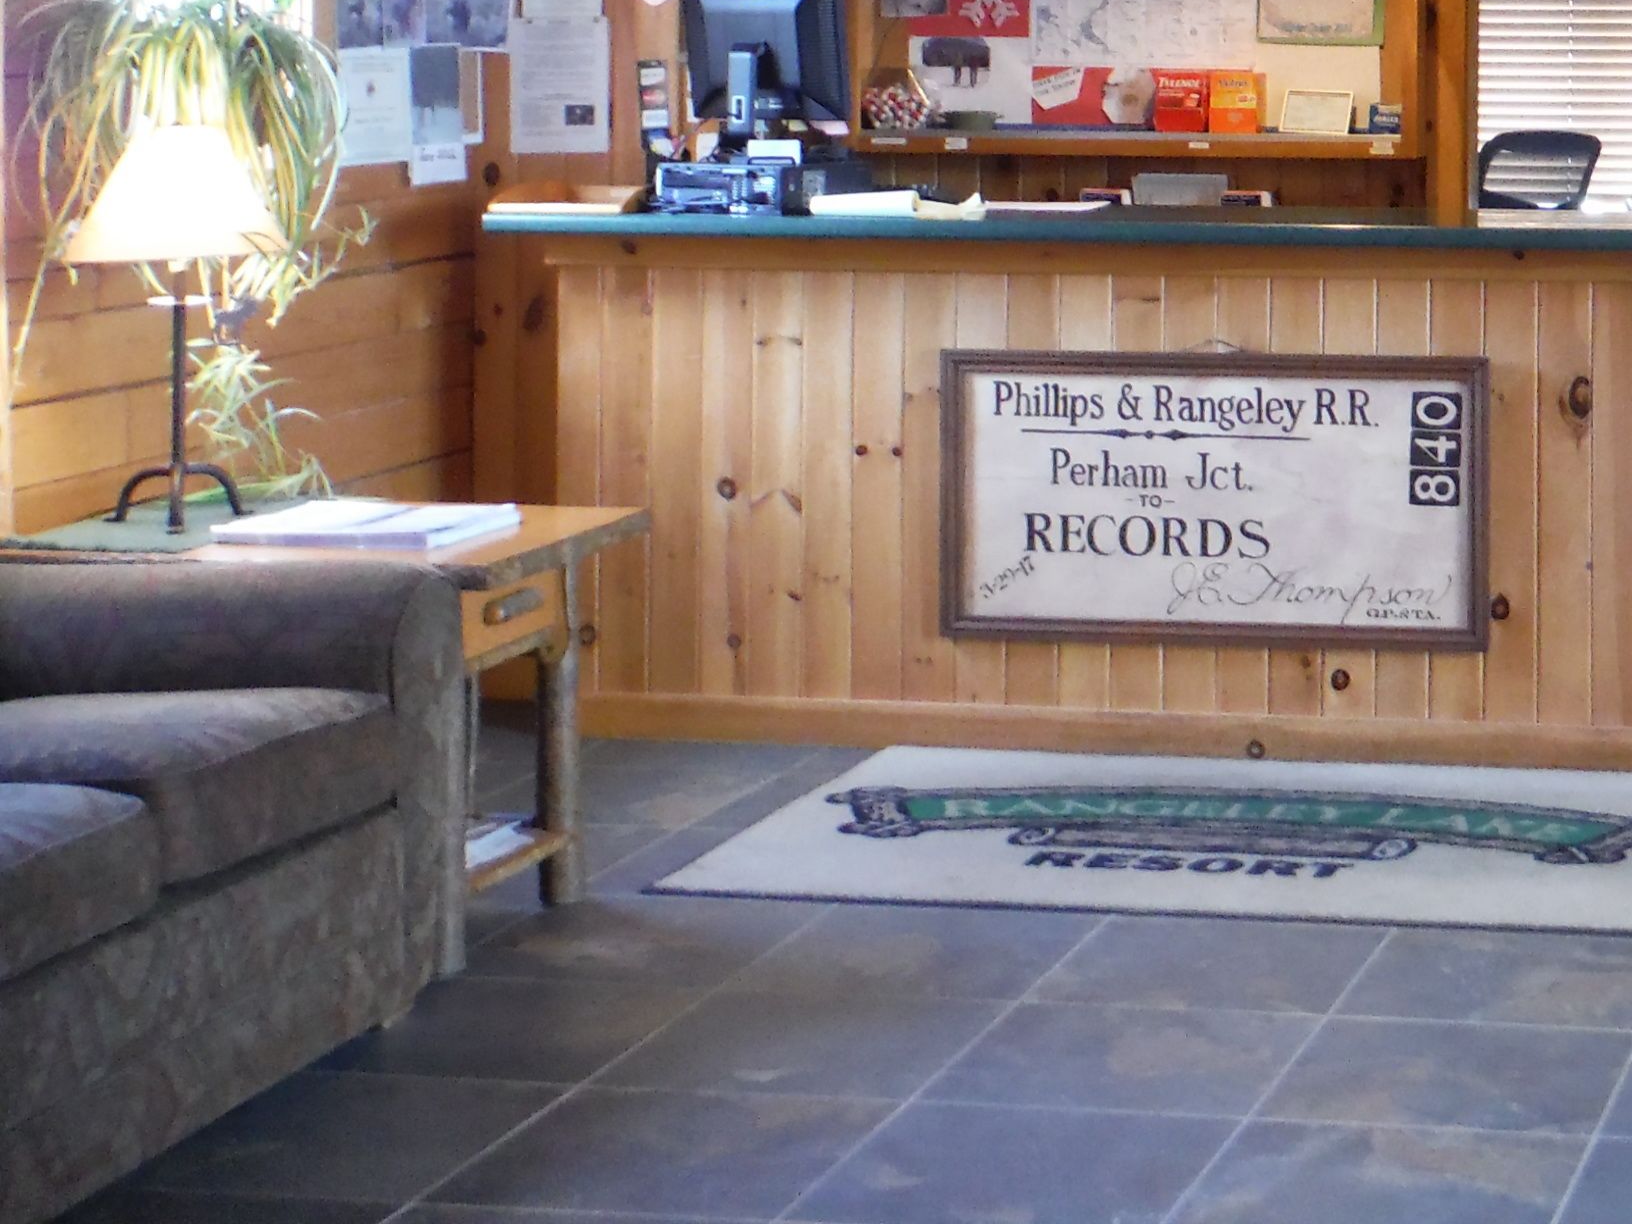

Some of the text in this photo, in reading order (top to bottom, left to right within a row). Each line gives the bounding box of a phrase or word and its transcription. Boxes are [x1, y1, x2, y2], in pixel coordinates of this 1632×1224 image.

[1158, 77, 1200, 88] TYLENOL
[993, 381, 1380, 433] Phillips & Rangeley R.R.
[1050, 448, 1254, 492] Perham Jct.
[1024, 512, 1272, 560] RECORDS
[944, 798, 1582, 845] RANGELEY LAKE
[1023, 851, 1356, 878] RESORT
